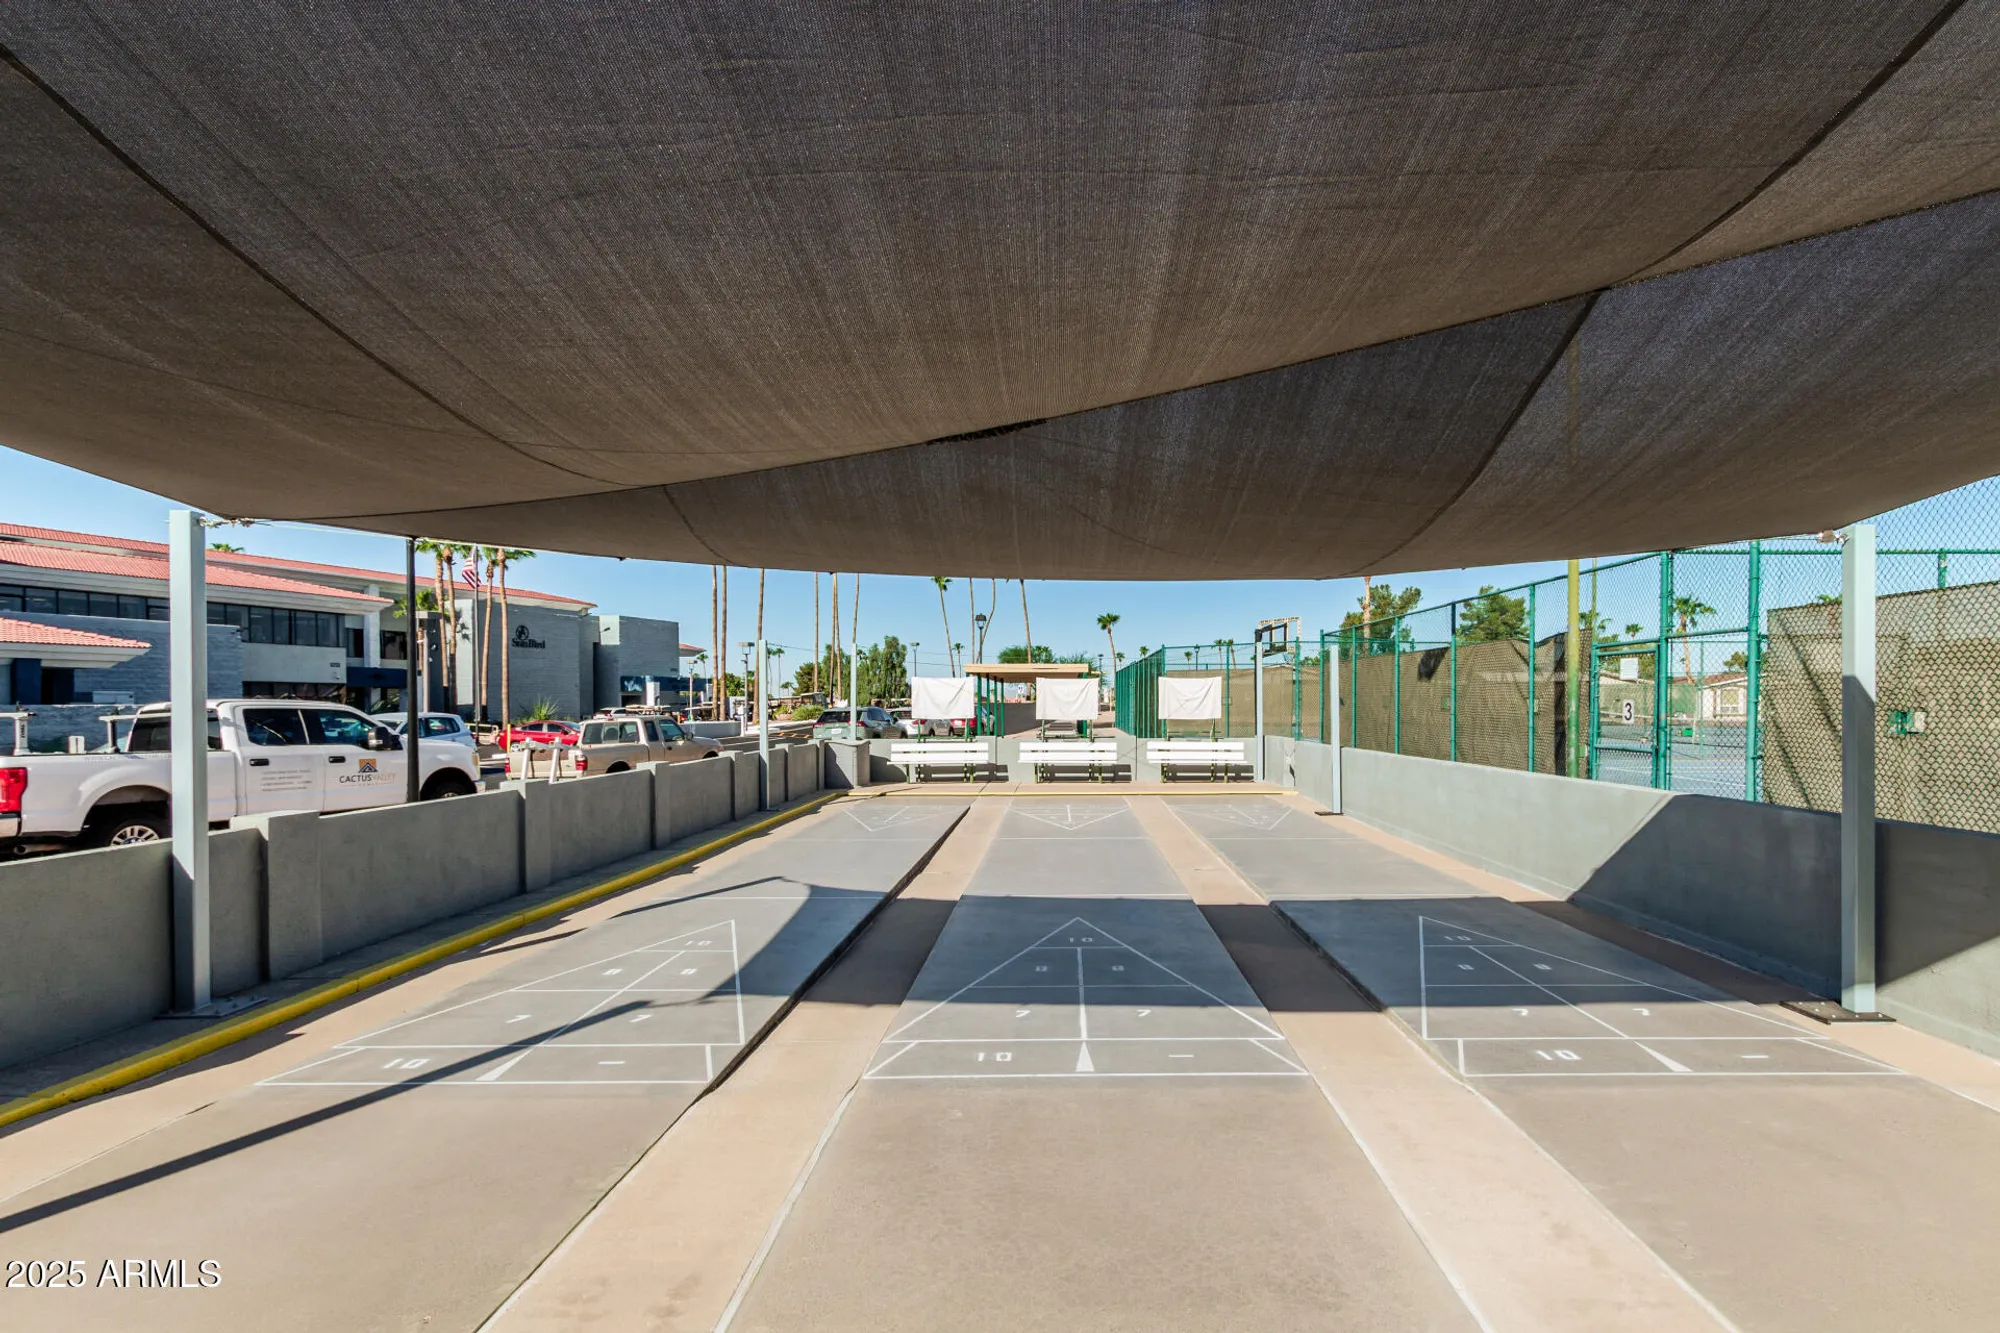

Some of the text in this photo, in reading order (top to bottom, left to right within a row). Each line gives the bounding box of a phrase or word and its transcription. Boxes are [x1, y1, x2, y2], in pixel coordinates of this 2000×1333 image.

[1624, 702, 1633, 721] 3
[339, 774, 372, 784] CACTUS
[1016, 1009, 1031, 1017] 7
[1137, 1009, 1152, 1017] 7
[976, 1052, 1012, 1062] 10
[1535, 1049, 1582, 1061] 10
[381, 1058, 431, 1069] 10
